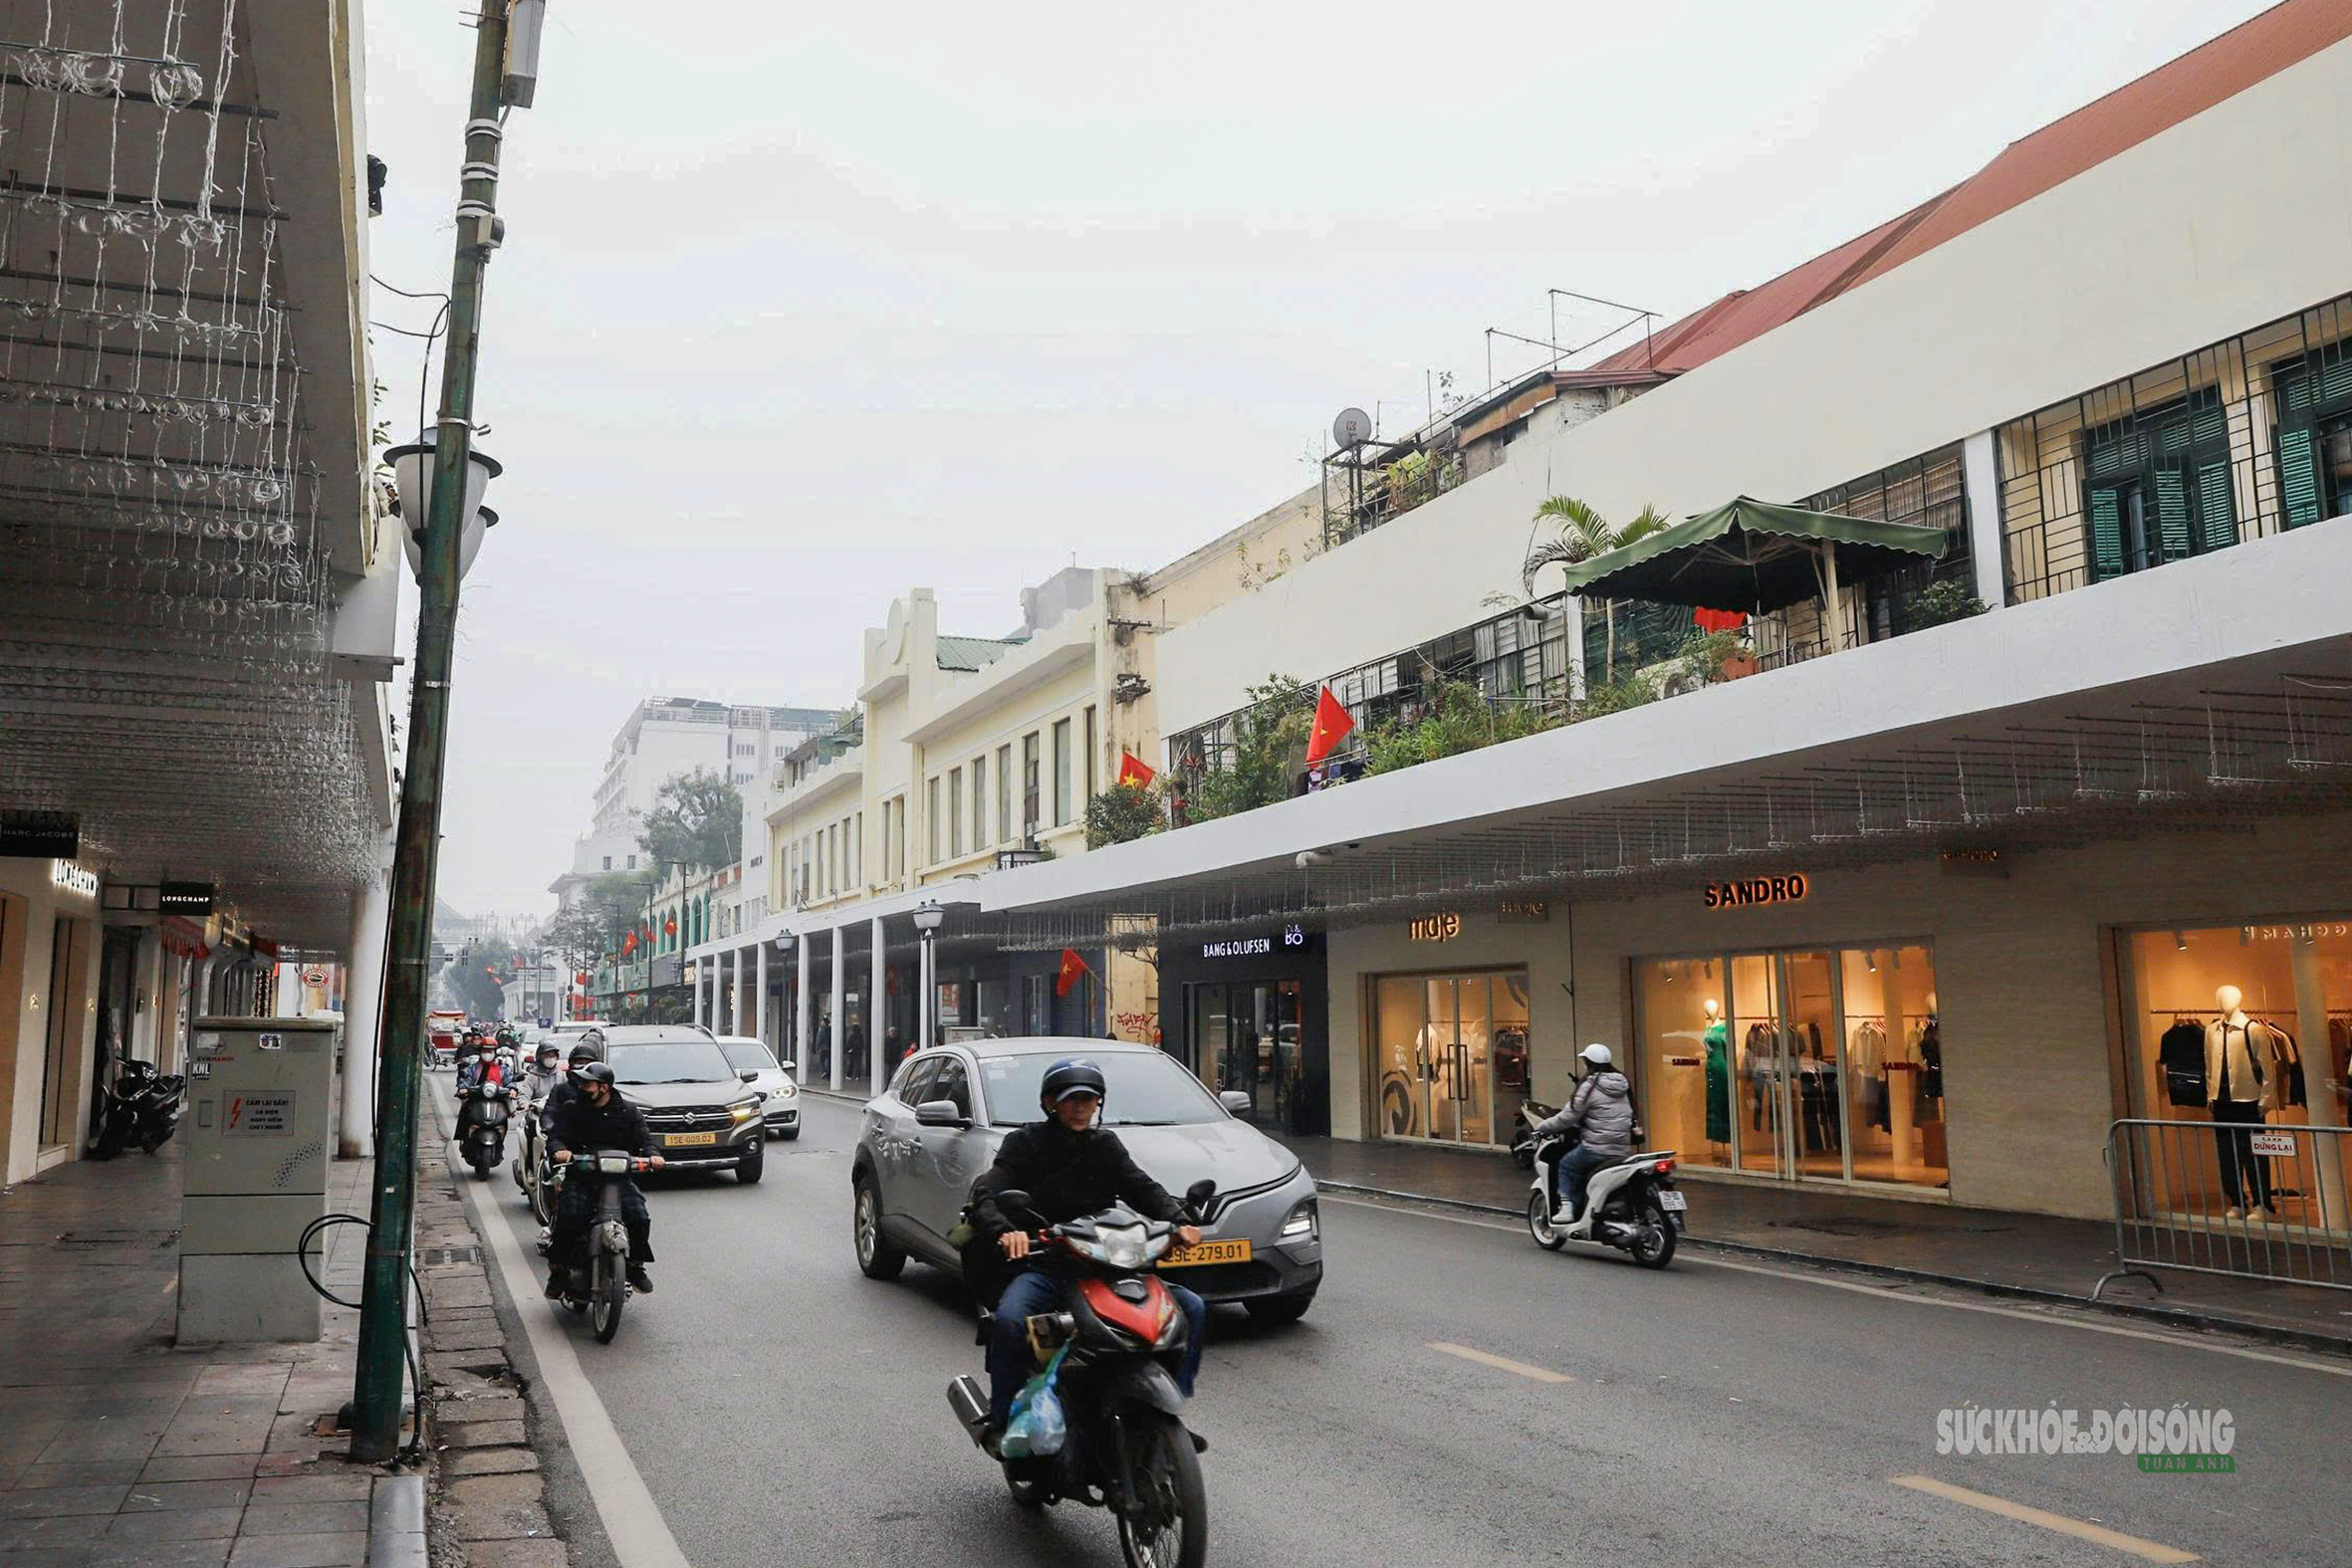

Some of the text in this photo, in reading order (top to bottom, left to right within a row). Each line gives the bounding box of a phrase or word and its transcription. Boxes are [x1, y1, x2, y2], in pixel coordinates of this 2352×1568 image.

[161, 895, 210, 904] LONGCHAMP
[1704, 874, 1806, 909] SANDRO
[1409, 910, 1461, 943] maje
[1203, 943, 1226, 958] BANG
[1233, 938, 1271, 956] OLUFSEN
[192, 1062, 210, 1075] KNL
